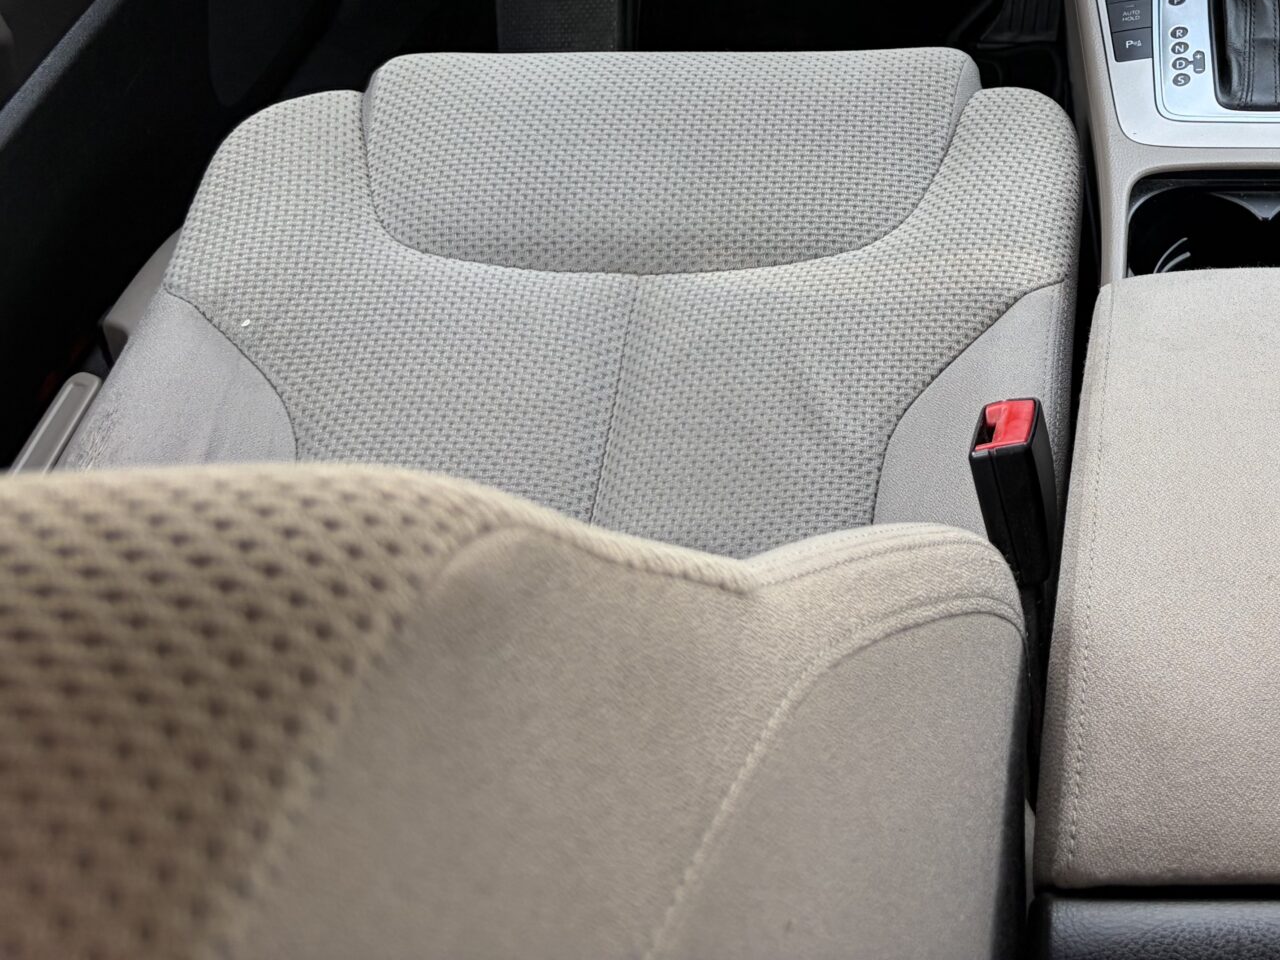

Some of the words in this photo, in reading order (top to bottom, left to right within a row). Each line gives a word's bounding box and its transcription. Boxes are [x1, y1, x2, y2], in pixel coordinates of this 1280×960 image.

[1175, 29, 1183, 37] R
[1174, 44, 1184, 53] N
[1176, 61, 1185, 69] D
[1177, 76, 1185, 84] S
